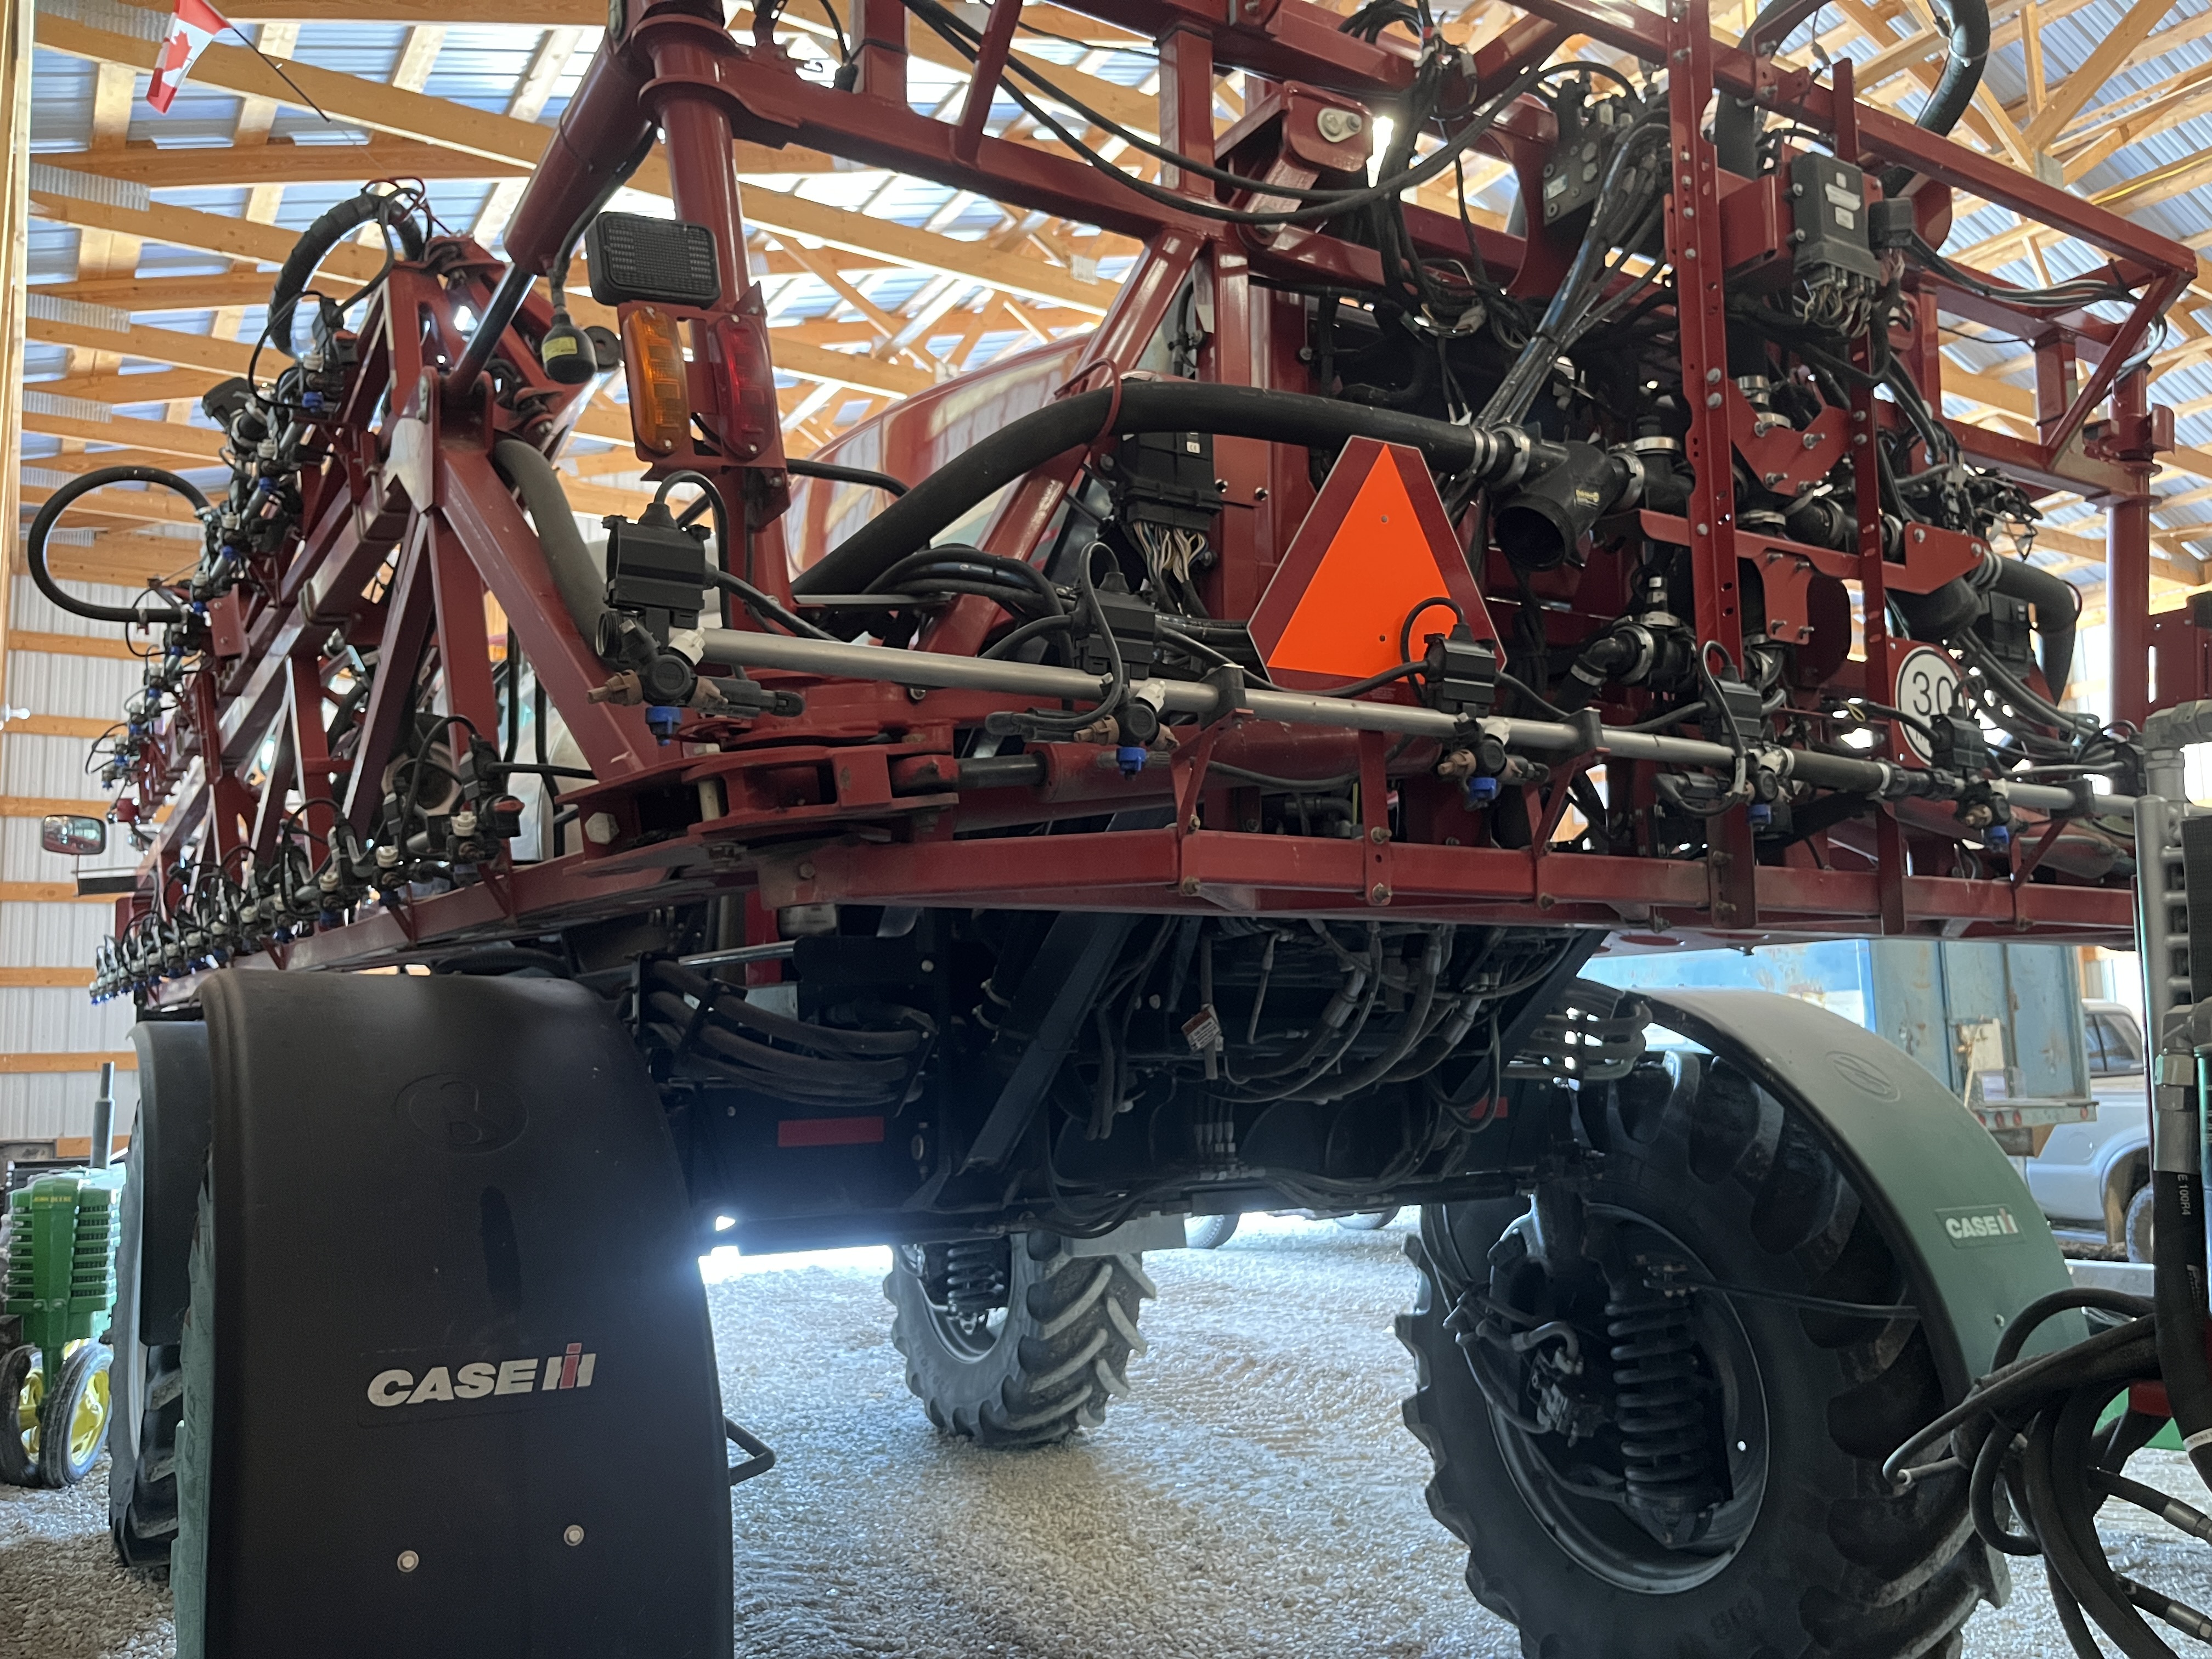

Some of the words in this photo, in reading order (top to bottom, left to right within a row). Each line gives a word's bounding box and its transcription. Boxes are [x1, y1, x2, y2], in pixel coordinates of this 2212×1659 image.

[1912, 671, 1954, 716] 30
[2177, 1183, 2191, 1216] 100R4
[1945, 1214, 2001, 1239] CASE
[366, 1358, 539, 1407] CASE
